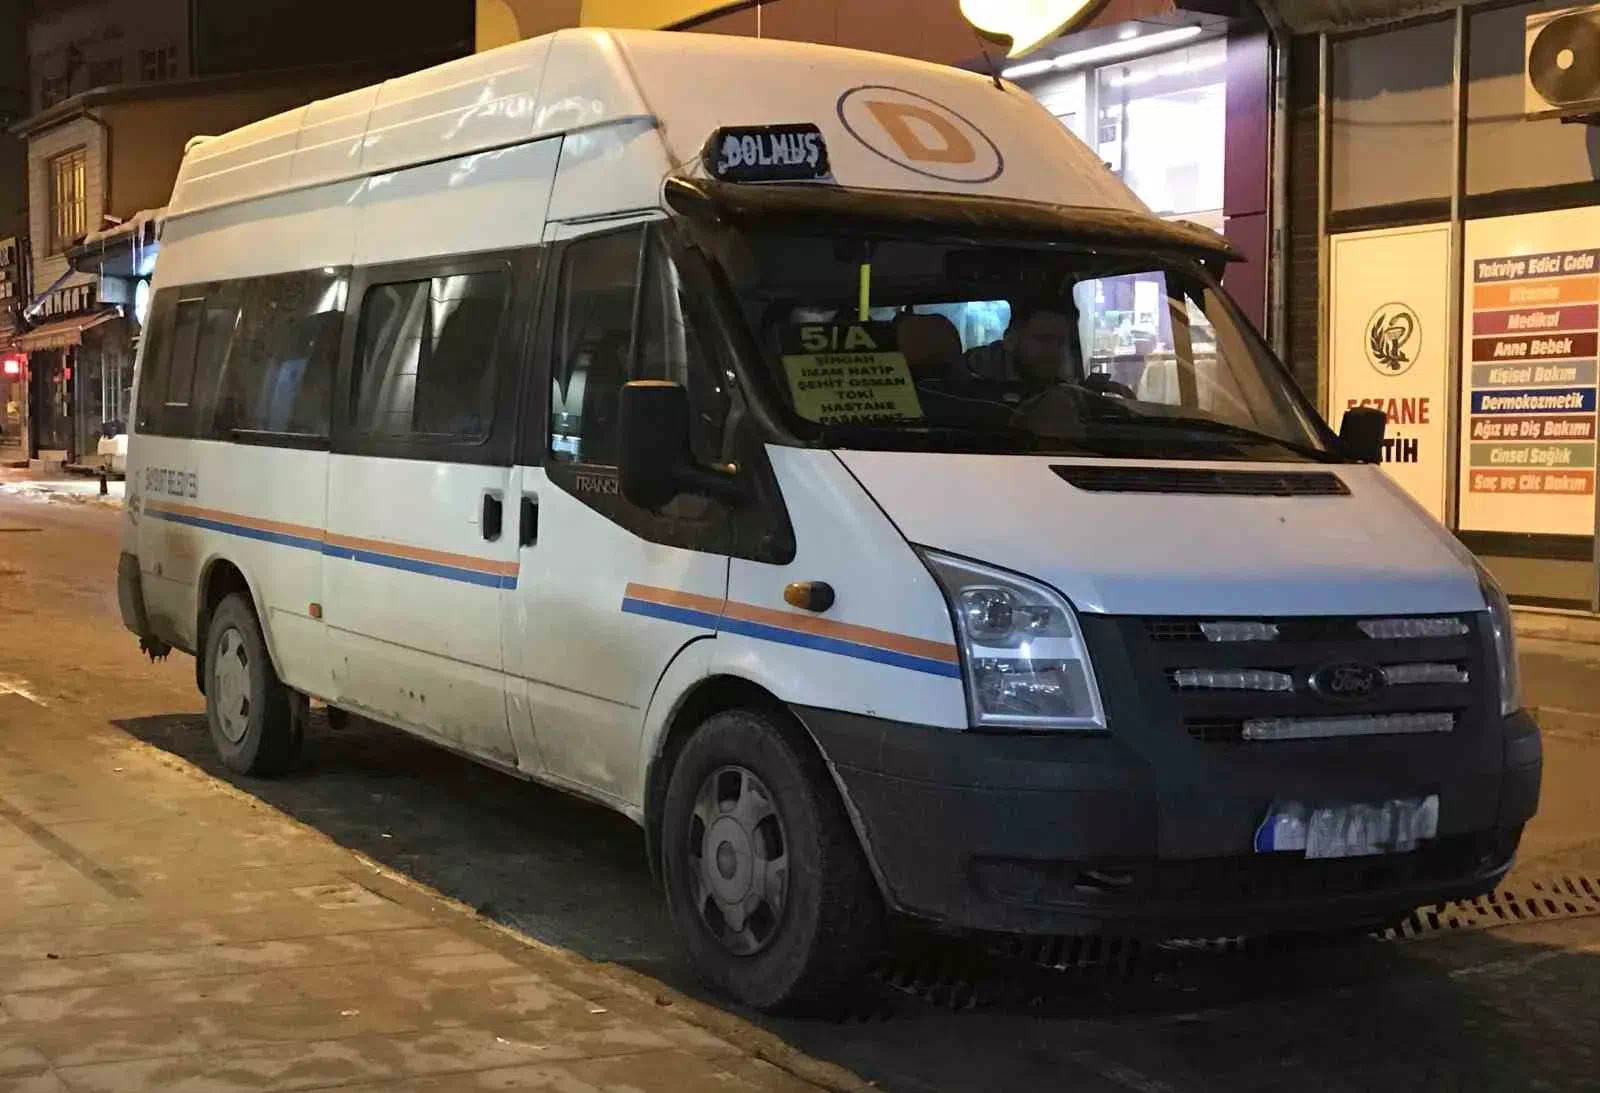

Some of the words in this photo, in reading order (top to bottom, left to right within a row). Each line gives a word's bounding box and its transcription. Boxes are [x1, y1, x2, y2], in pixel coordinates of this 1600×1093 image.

[864, 100, 976, 164] D
[720, 132, 820, 171] DOLMUŞ
[1528, 255, 1560, 274] Edici
[1507, 311, 1560, 329] Medikal
[1494, 341, 1528, 357] Anne
[1530, 337, 1573, 355] Bebek
[820, 401, 896, 413] HASTANE
[1481, 392, 1584, 410] Dermokozmetik
[1473, 420, 1501, 439] Ağız
[1503, 423, 1518, 436] ve
[1519, 420, 1541, 438] Diş
[1543, 420, 1591, 436] Bakımı
[1490, 447, 1530, 464] Cinsel
[1530, 447, 1572, 465] Sağlık
[1474, 474, 1497, 491] Saç
[1500, 476, 1517, 490] ve
